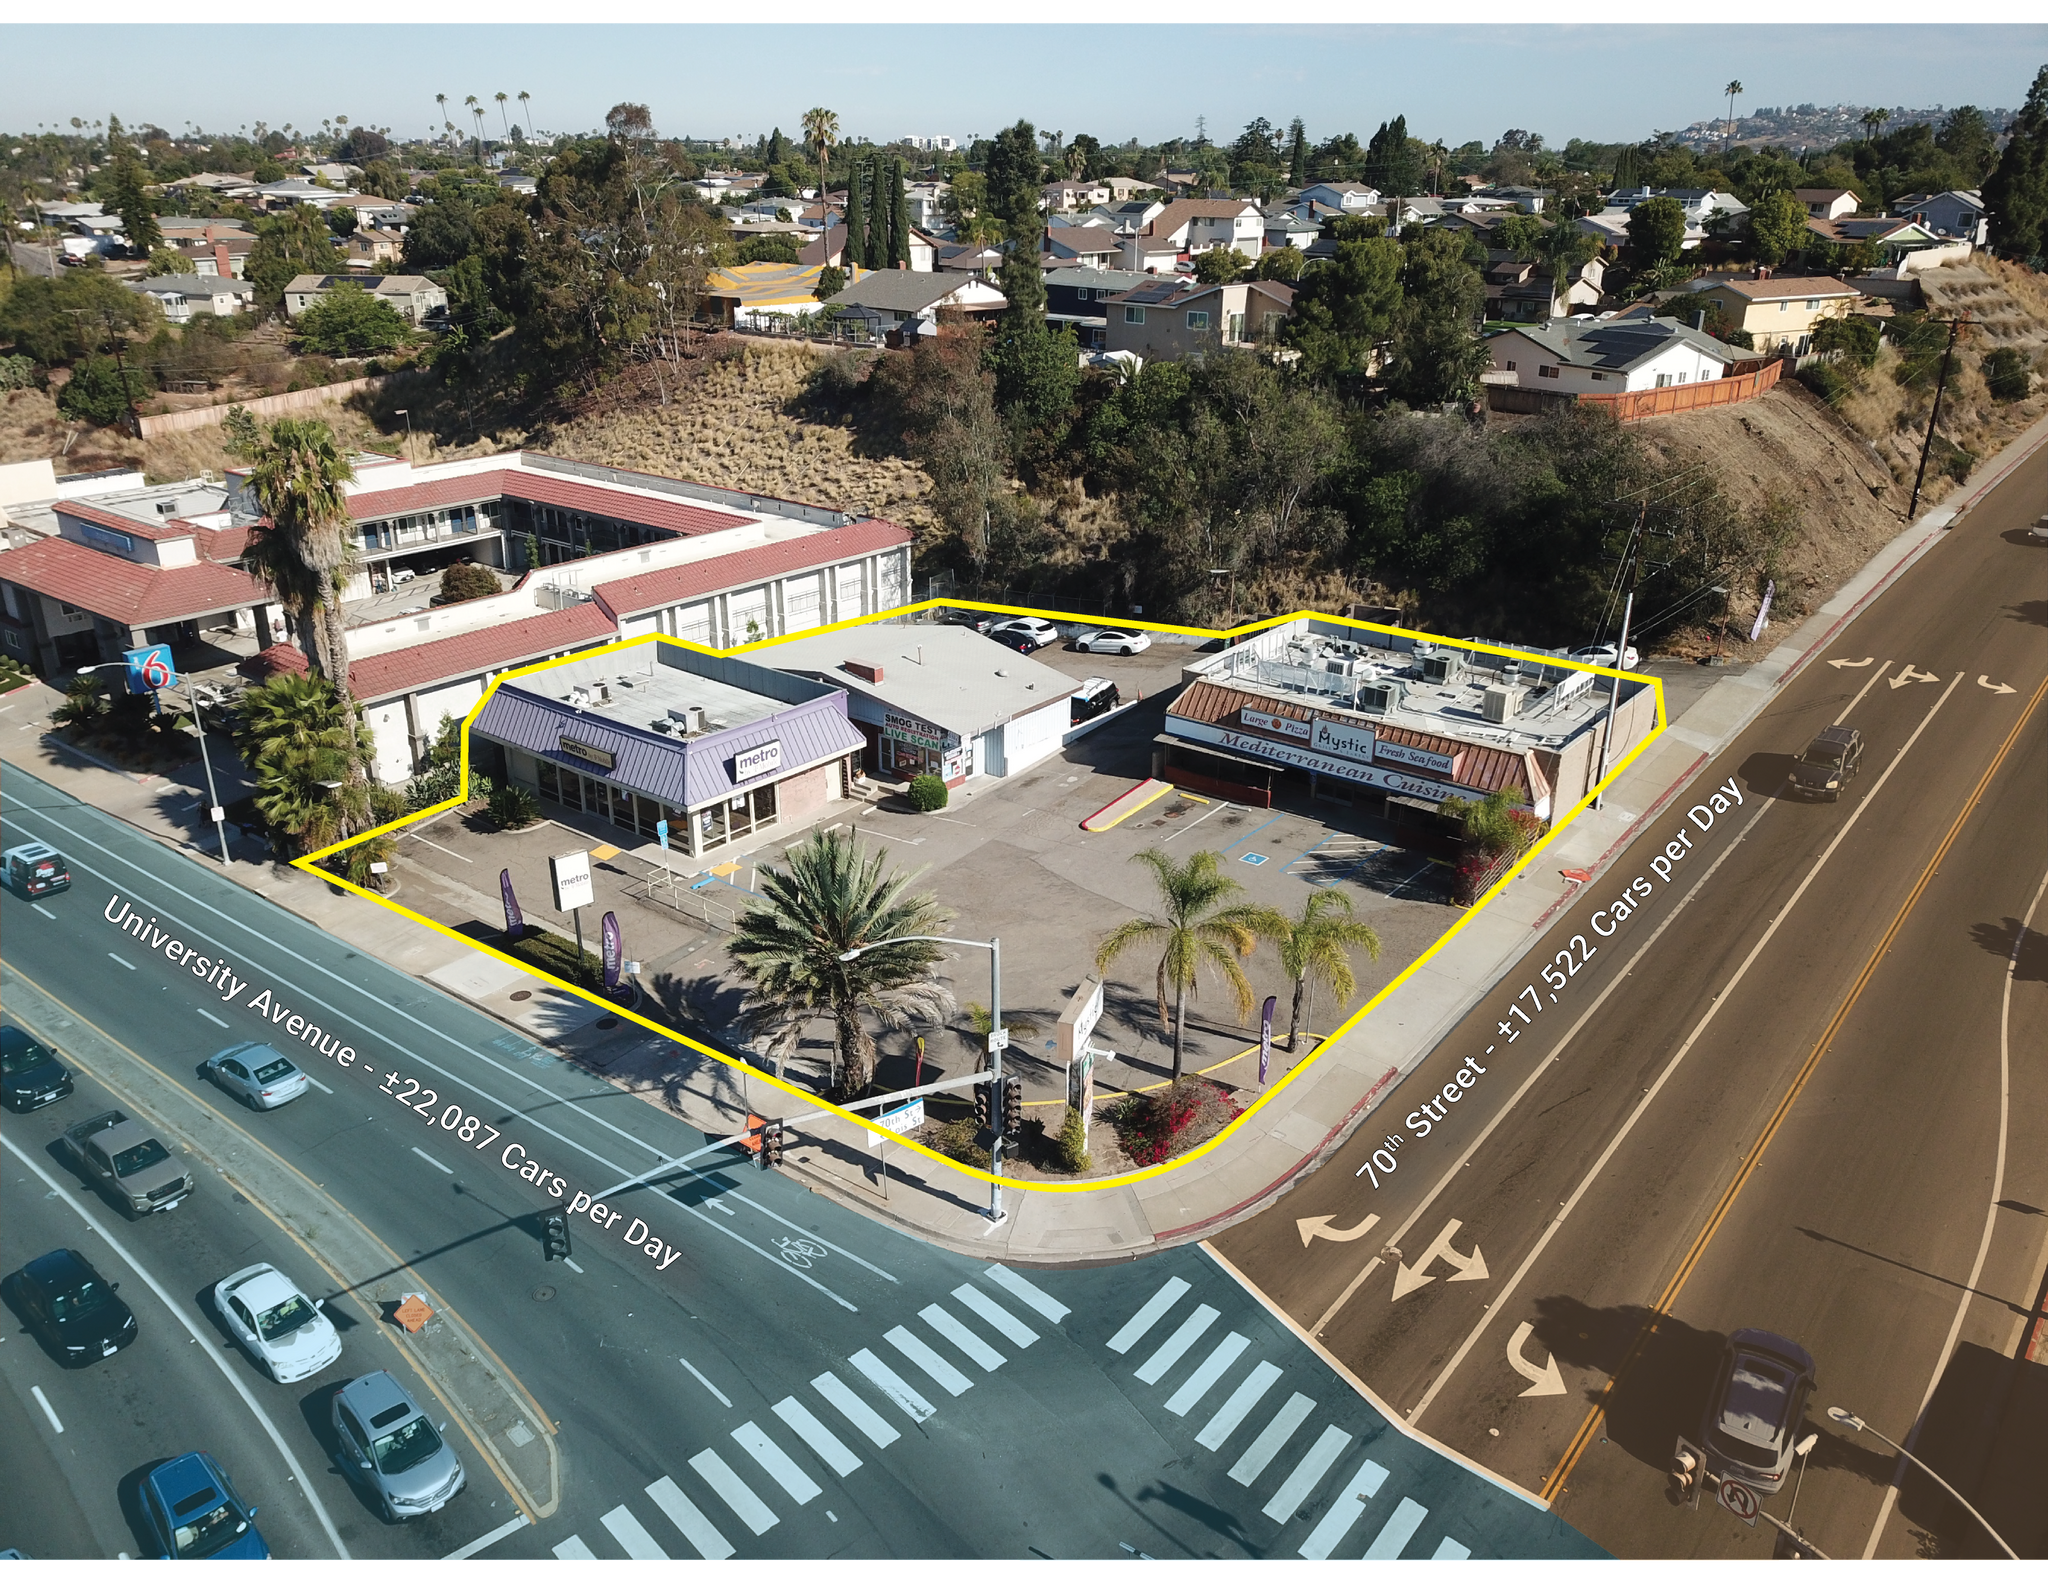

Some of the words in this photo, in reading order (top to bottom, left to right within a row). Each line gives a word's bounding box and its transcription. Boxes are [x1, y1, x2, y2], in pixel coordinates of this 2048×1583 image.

[142, 650, 170, 690] 6
[885, 713, 912, 728] SMOG
[915, 722, 939, 735] TEST
[1243, 713, 1268, 726] Large
[1285, 723, 1309, 736] Pizza
[562, 741, 588, 756] metro
[885, 728, 907, 741] LIVE
[910, 733, 939, 750] SCAN
[1318, 730, 1367, 754] Mystic
[740, 747, 778, 769] metro
[1219, 732, 1374, 782] Mediterranean
[1378, 745, 1405, 759] Fresh
[561, 873, 589, 886] metro
[604, 931, 616, 970] metro
[880, 1115, 900, 1128] 70th
[904, 1110, 914, 1119] St
[912, 1116, 921, 1126] St
